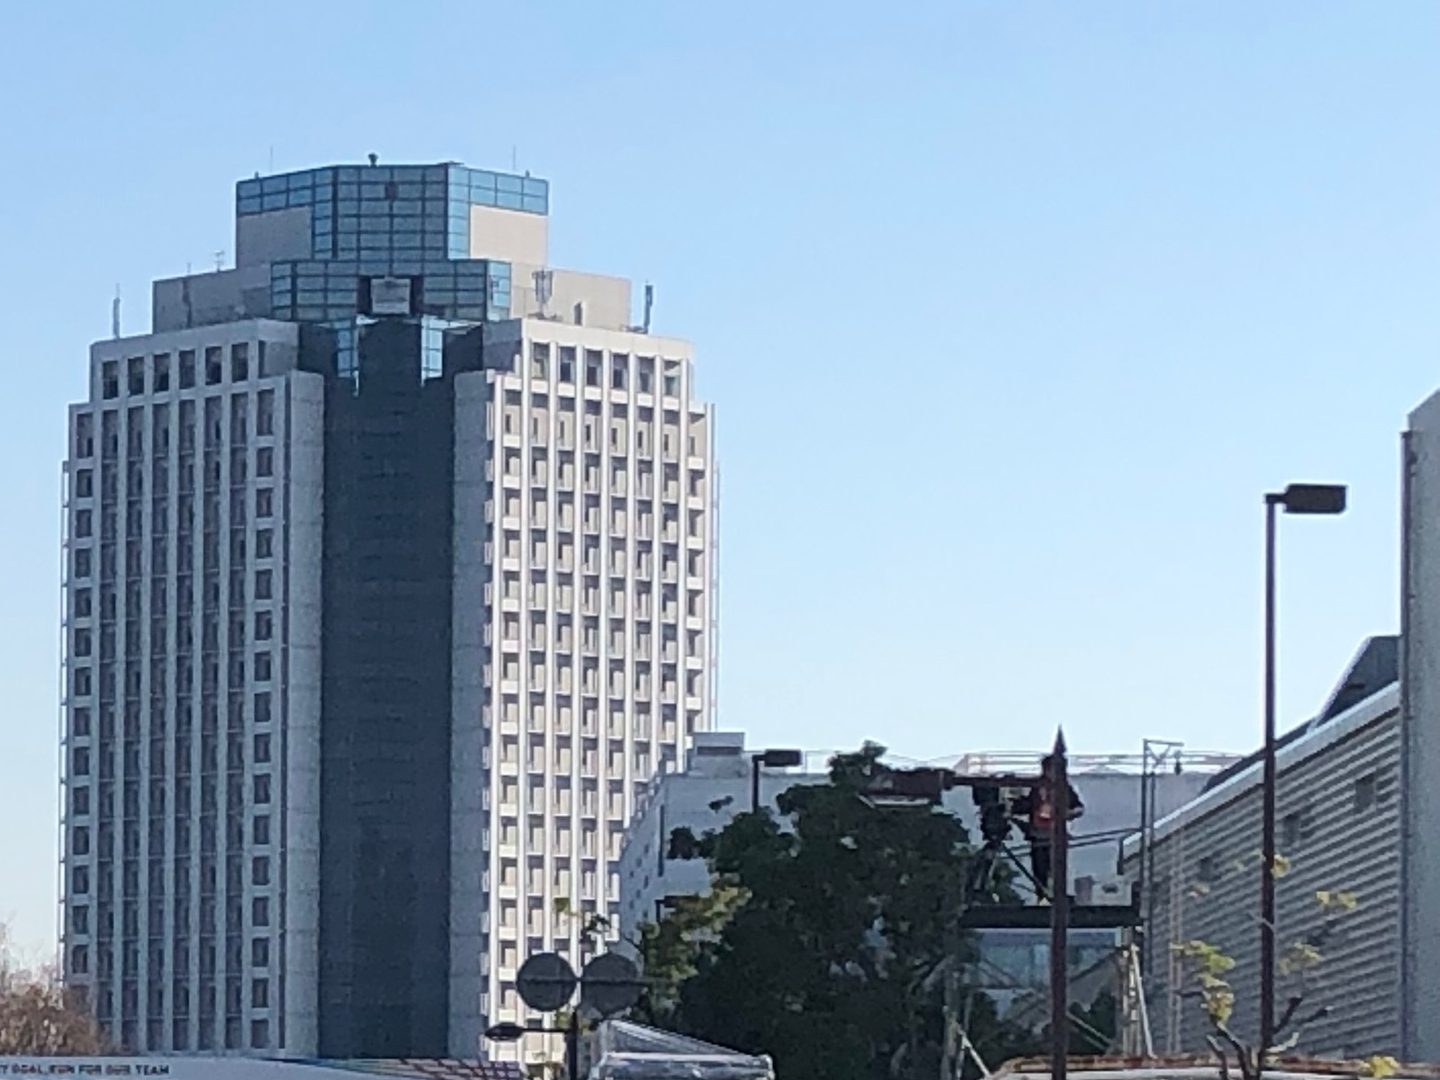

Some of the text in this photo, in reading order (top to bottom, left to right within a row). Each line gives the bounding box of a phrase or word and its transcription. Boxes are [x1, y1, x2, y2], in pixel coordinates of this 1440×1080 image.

[78, 1065, 101, 1076] FOR
[105, 1065, 130, 1076] OUR
[135, 1065, 169, 1076] TEAM
